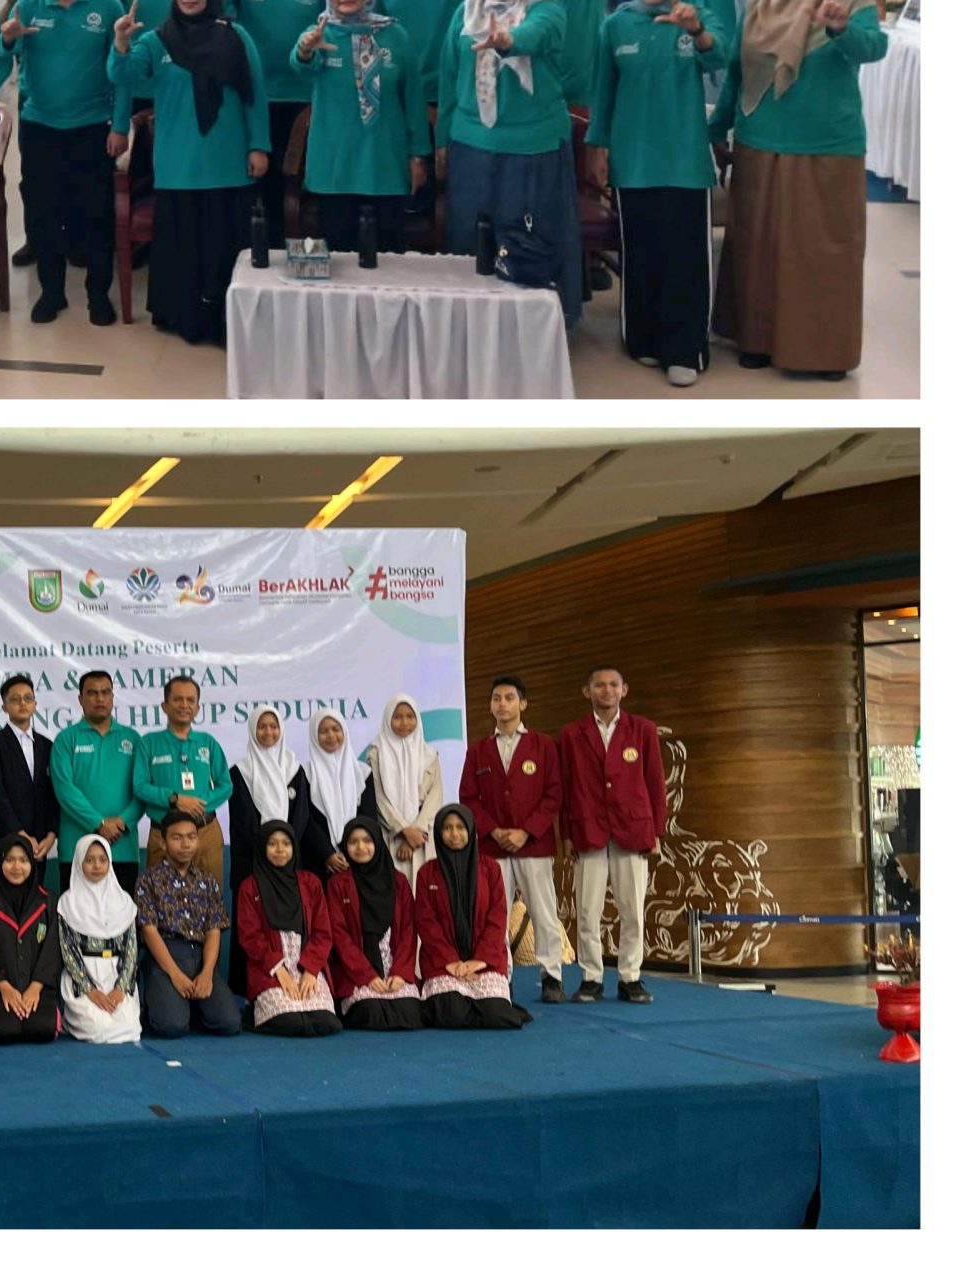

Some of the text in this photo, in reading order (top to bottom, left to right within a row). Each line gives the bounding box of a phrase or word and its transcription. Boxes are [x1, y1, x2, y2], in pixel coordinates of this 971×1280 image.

[388, 566, 435, 578] bangga
[218, 582, 251, 594] Dumai
[258, 577, 350, 593] BerAKHLAK
[389, 576, 444, 590] melayani
[390, 589, 435, 602] bangsa
[77, 601, 109, 613] Dumai
[62, 641, 128, 659] Datang
[134, 639, 199, 656] Peserta
[129, 701, 226, 727] HIUP
